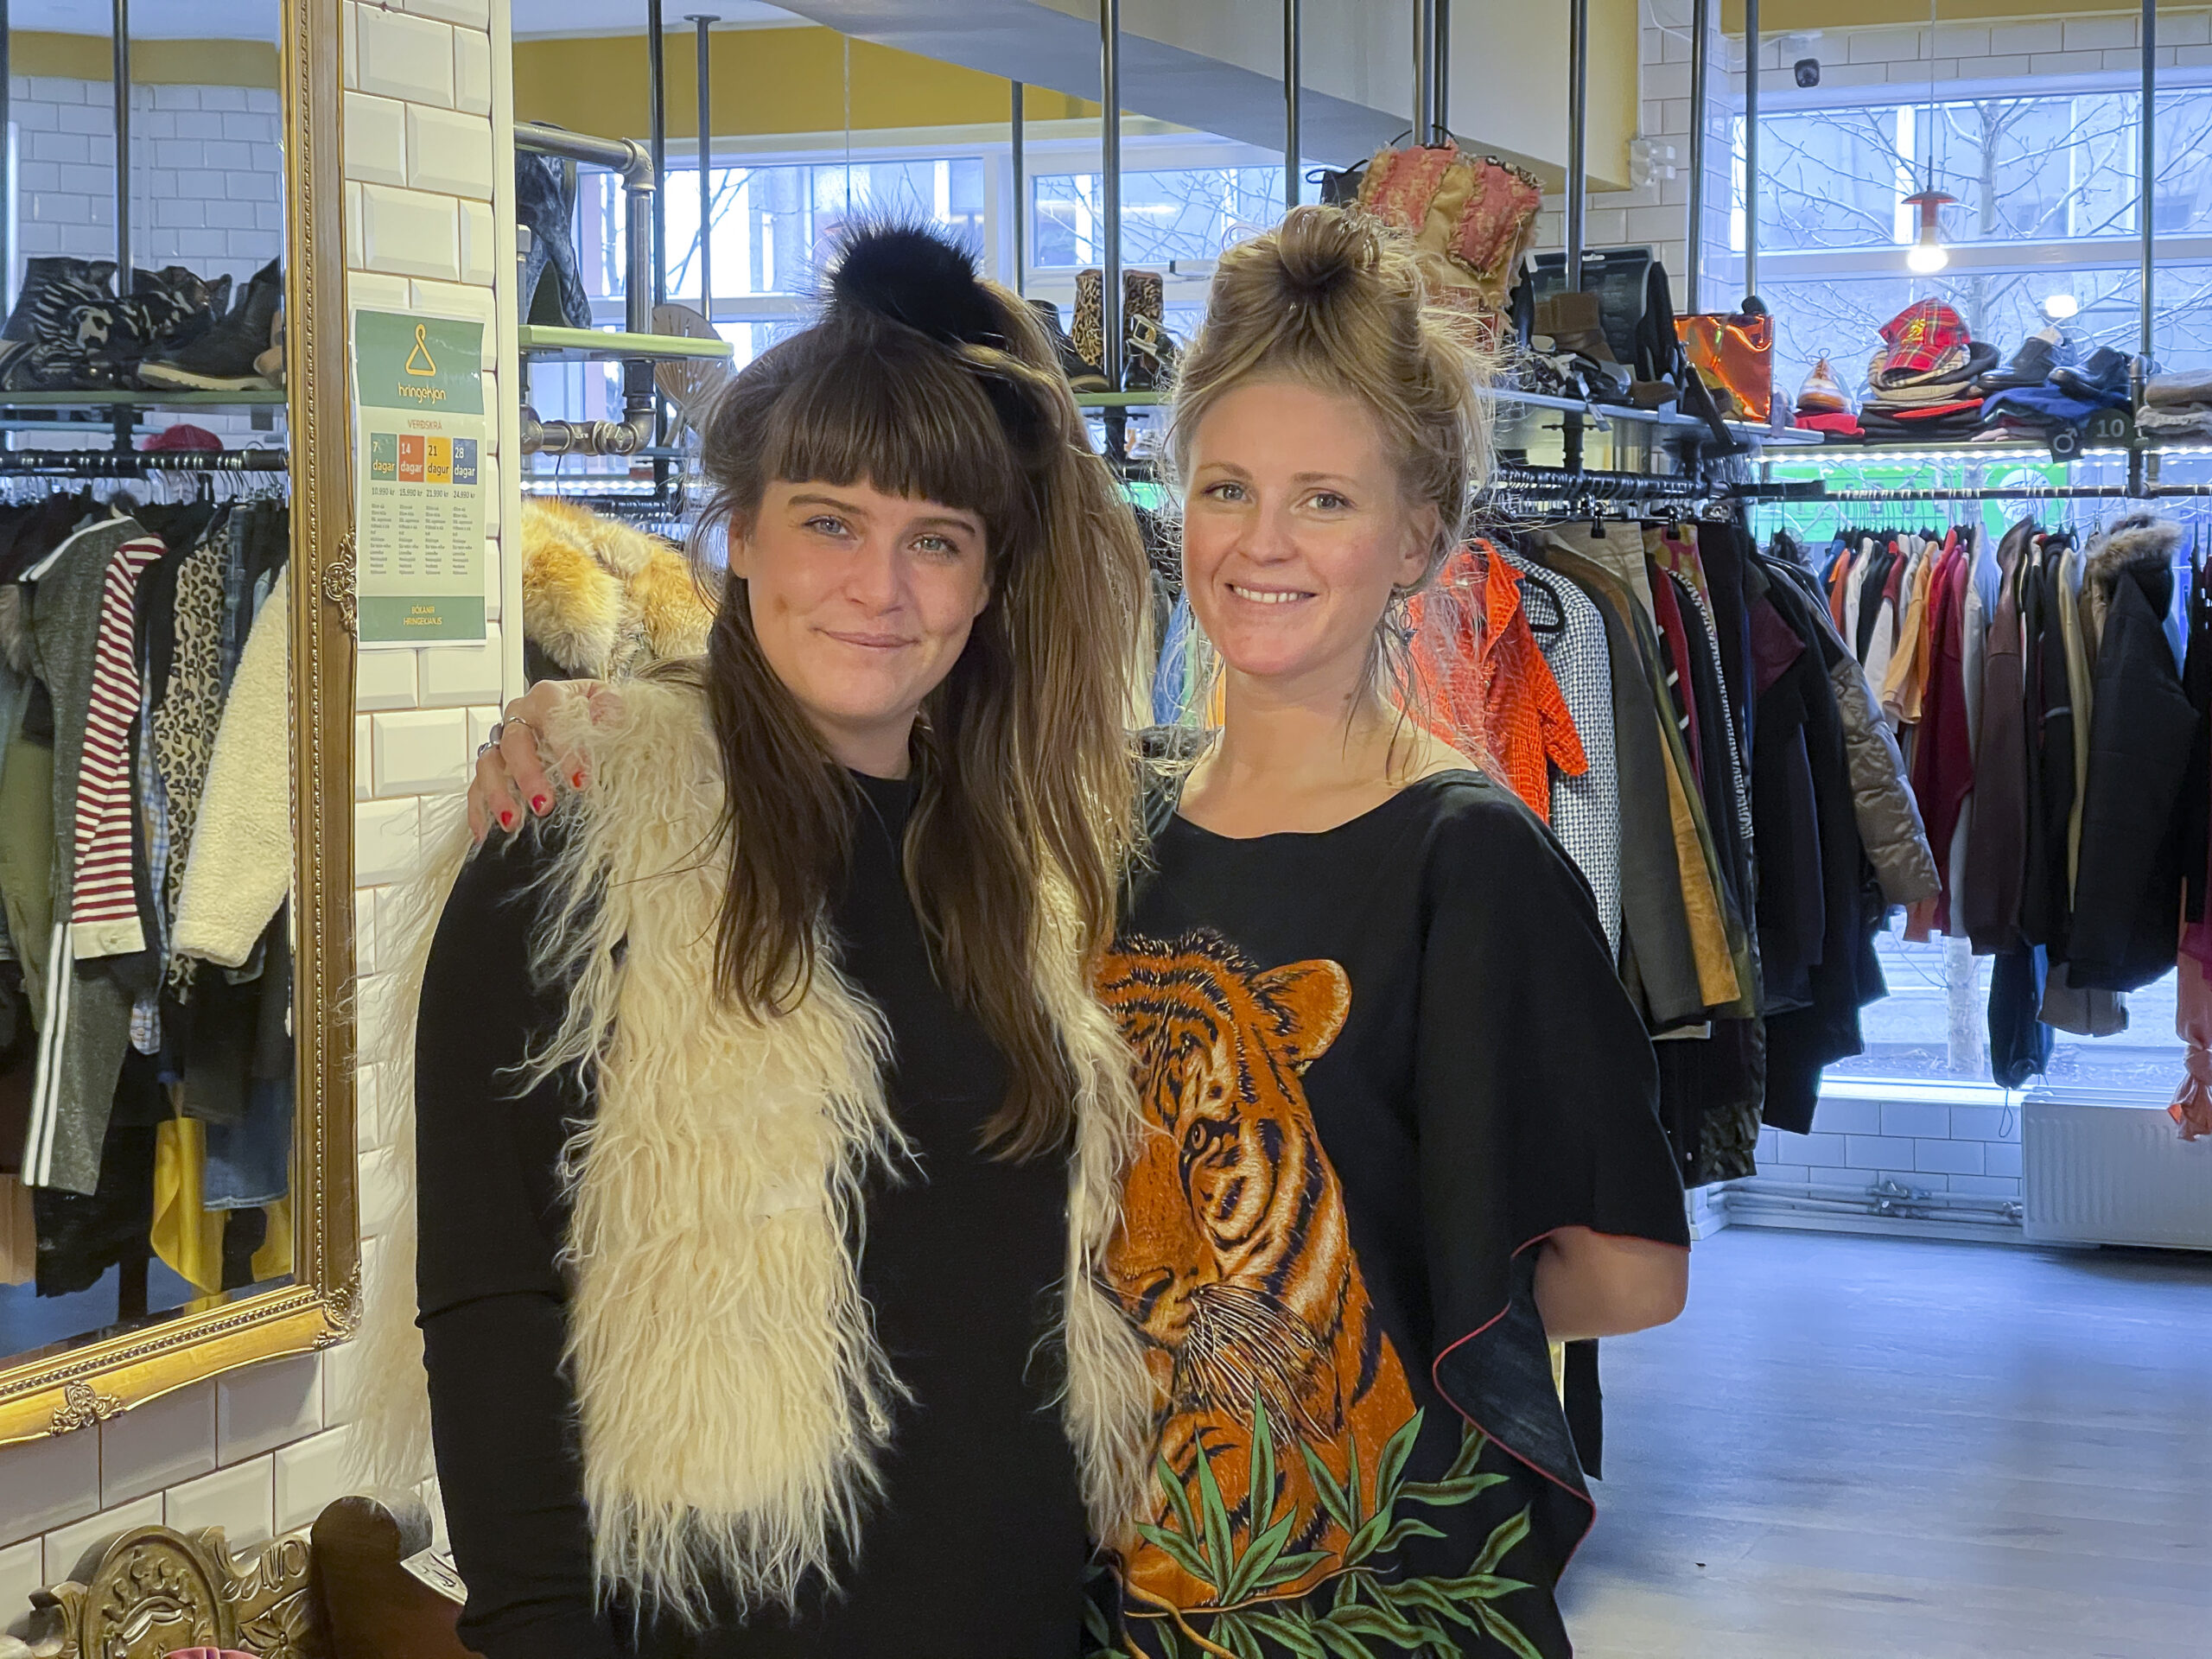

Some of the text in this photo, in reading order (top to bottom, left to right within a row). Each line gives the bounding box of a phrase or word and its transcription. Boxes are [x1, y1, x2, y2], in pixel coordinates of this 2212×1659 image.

[397, 382, 446, 404] hringekjan
[2096, 418, 2126, 438] 10
[372, 441, 378, 453] 7
[401, 442, 411, 454] 14
[428, 445, 438, 456] 21
[454, 447, 464, 459] 28
[372, 459, 395, 474] dagar
[400, 460, 423, 475] dagar
[454, 464, 475, 479] dagar
